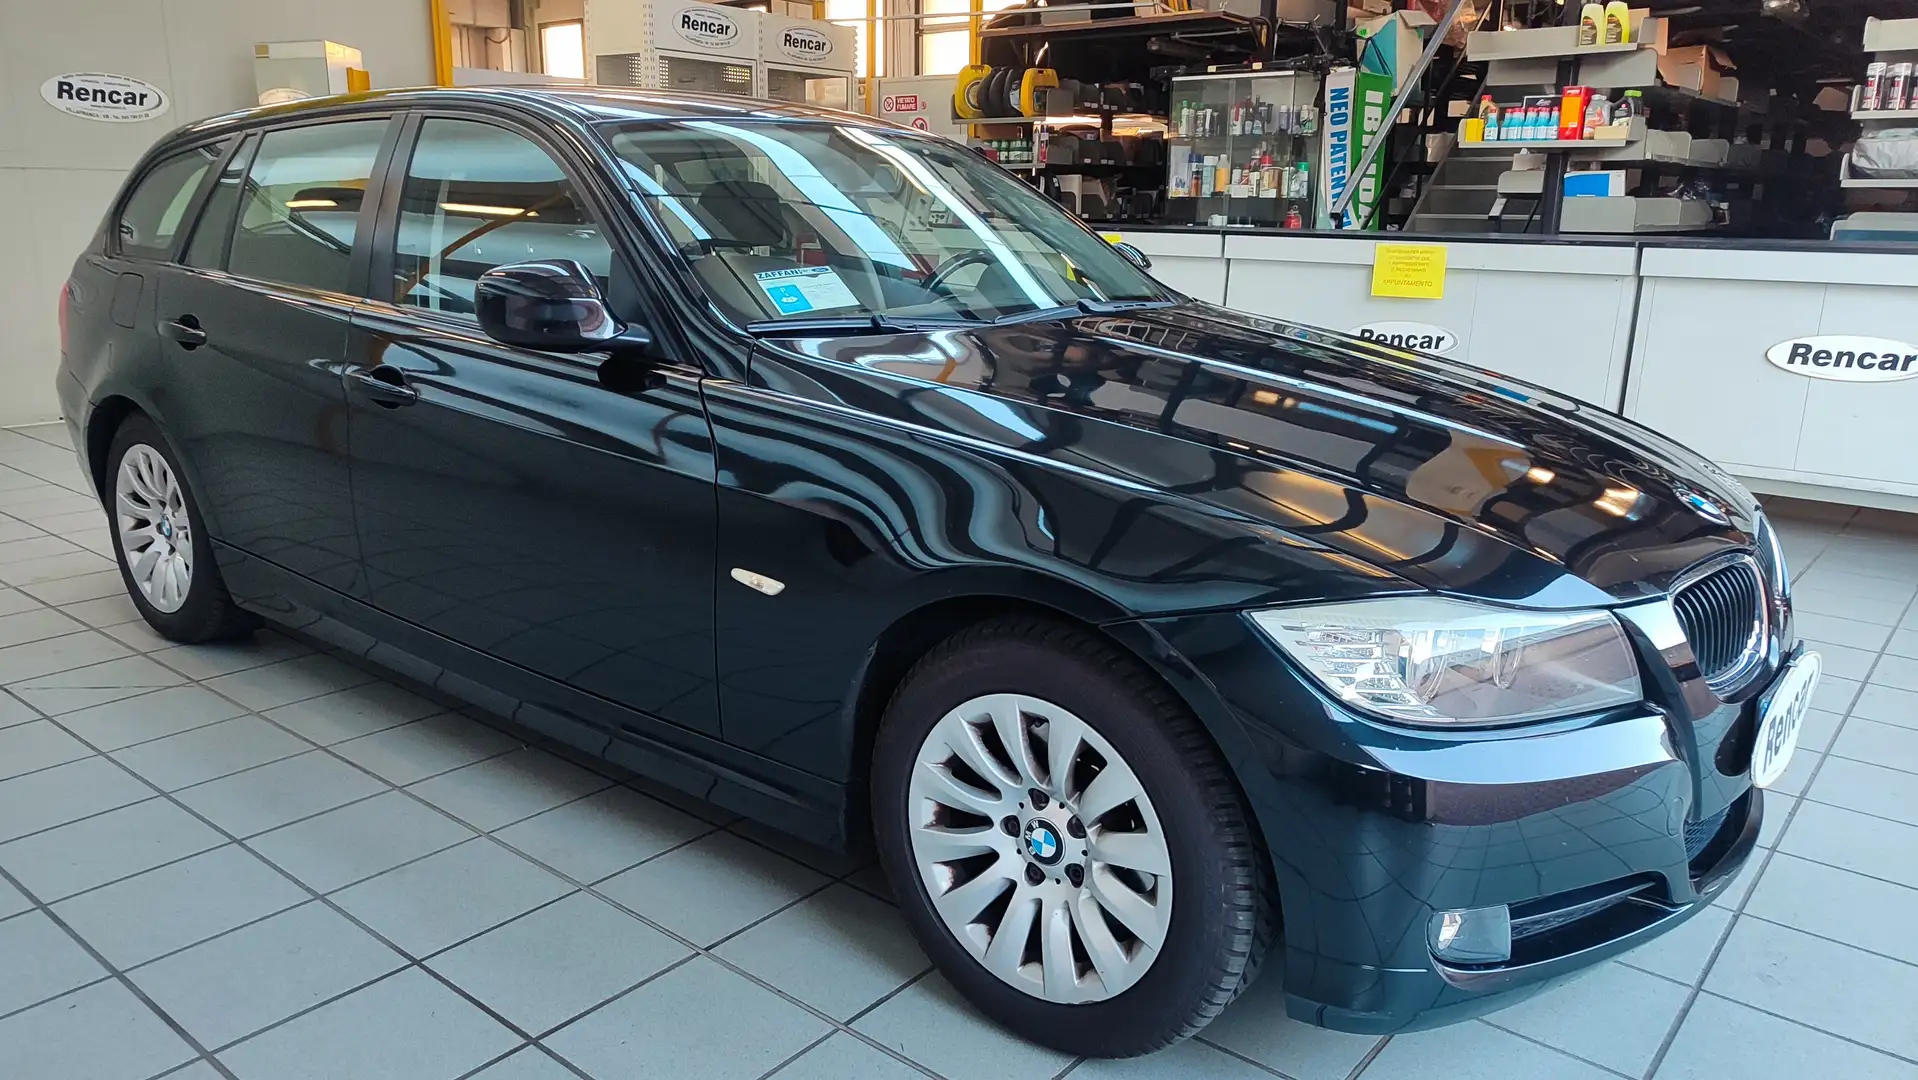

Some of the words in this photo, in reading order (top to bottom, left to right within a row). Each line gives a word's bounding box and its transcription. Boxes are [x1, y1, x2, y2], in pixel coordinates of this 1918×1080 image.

[681, 14, 730, 36] Rencar
[784, 33, 826, 52] Rencar
[57, 80, 148, 107] Rencar
[896, 96, 915, 104] VIETATO
[896, 103, 917, 111] FUMARE
[1329, 87, 1350, 127] NEO
[1382, 279, 1433, 288] APPUNTAMENTO
[1359, 328, 1446, 351] Rencar
[1786, 342, 1918, 372] Rencar
[1762, 669, 1815, 776] Rencar
